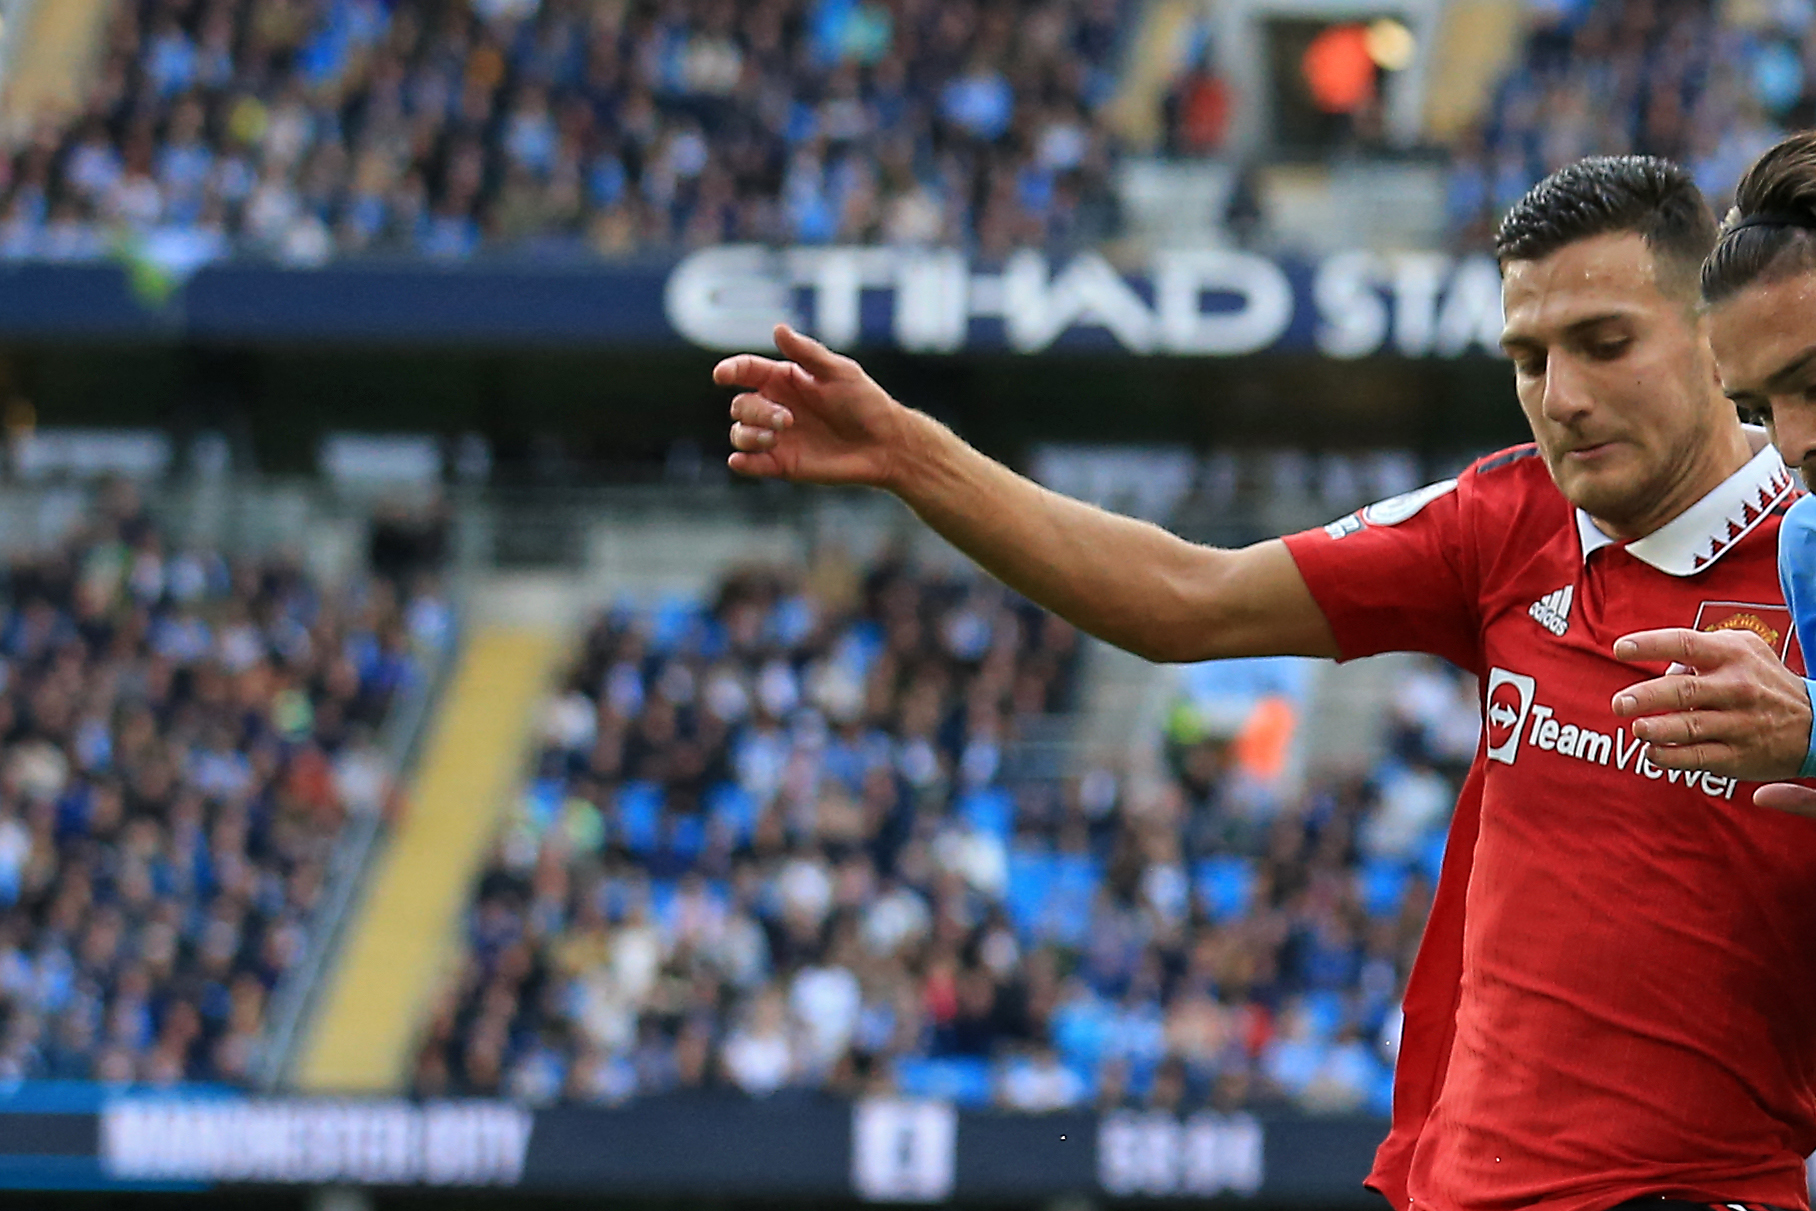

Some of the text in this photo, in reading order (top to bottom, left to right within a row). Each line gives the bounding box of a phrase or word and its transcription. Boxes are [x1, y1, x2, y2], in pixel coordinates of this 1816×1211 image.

[664, 248, 1512, 359] ETIHAD STA
[1528, 601, 1569, 637] adidas
